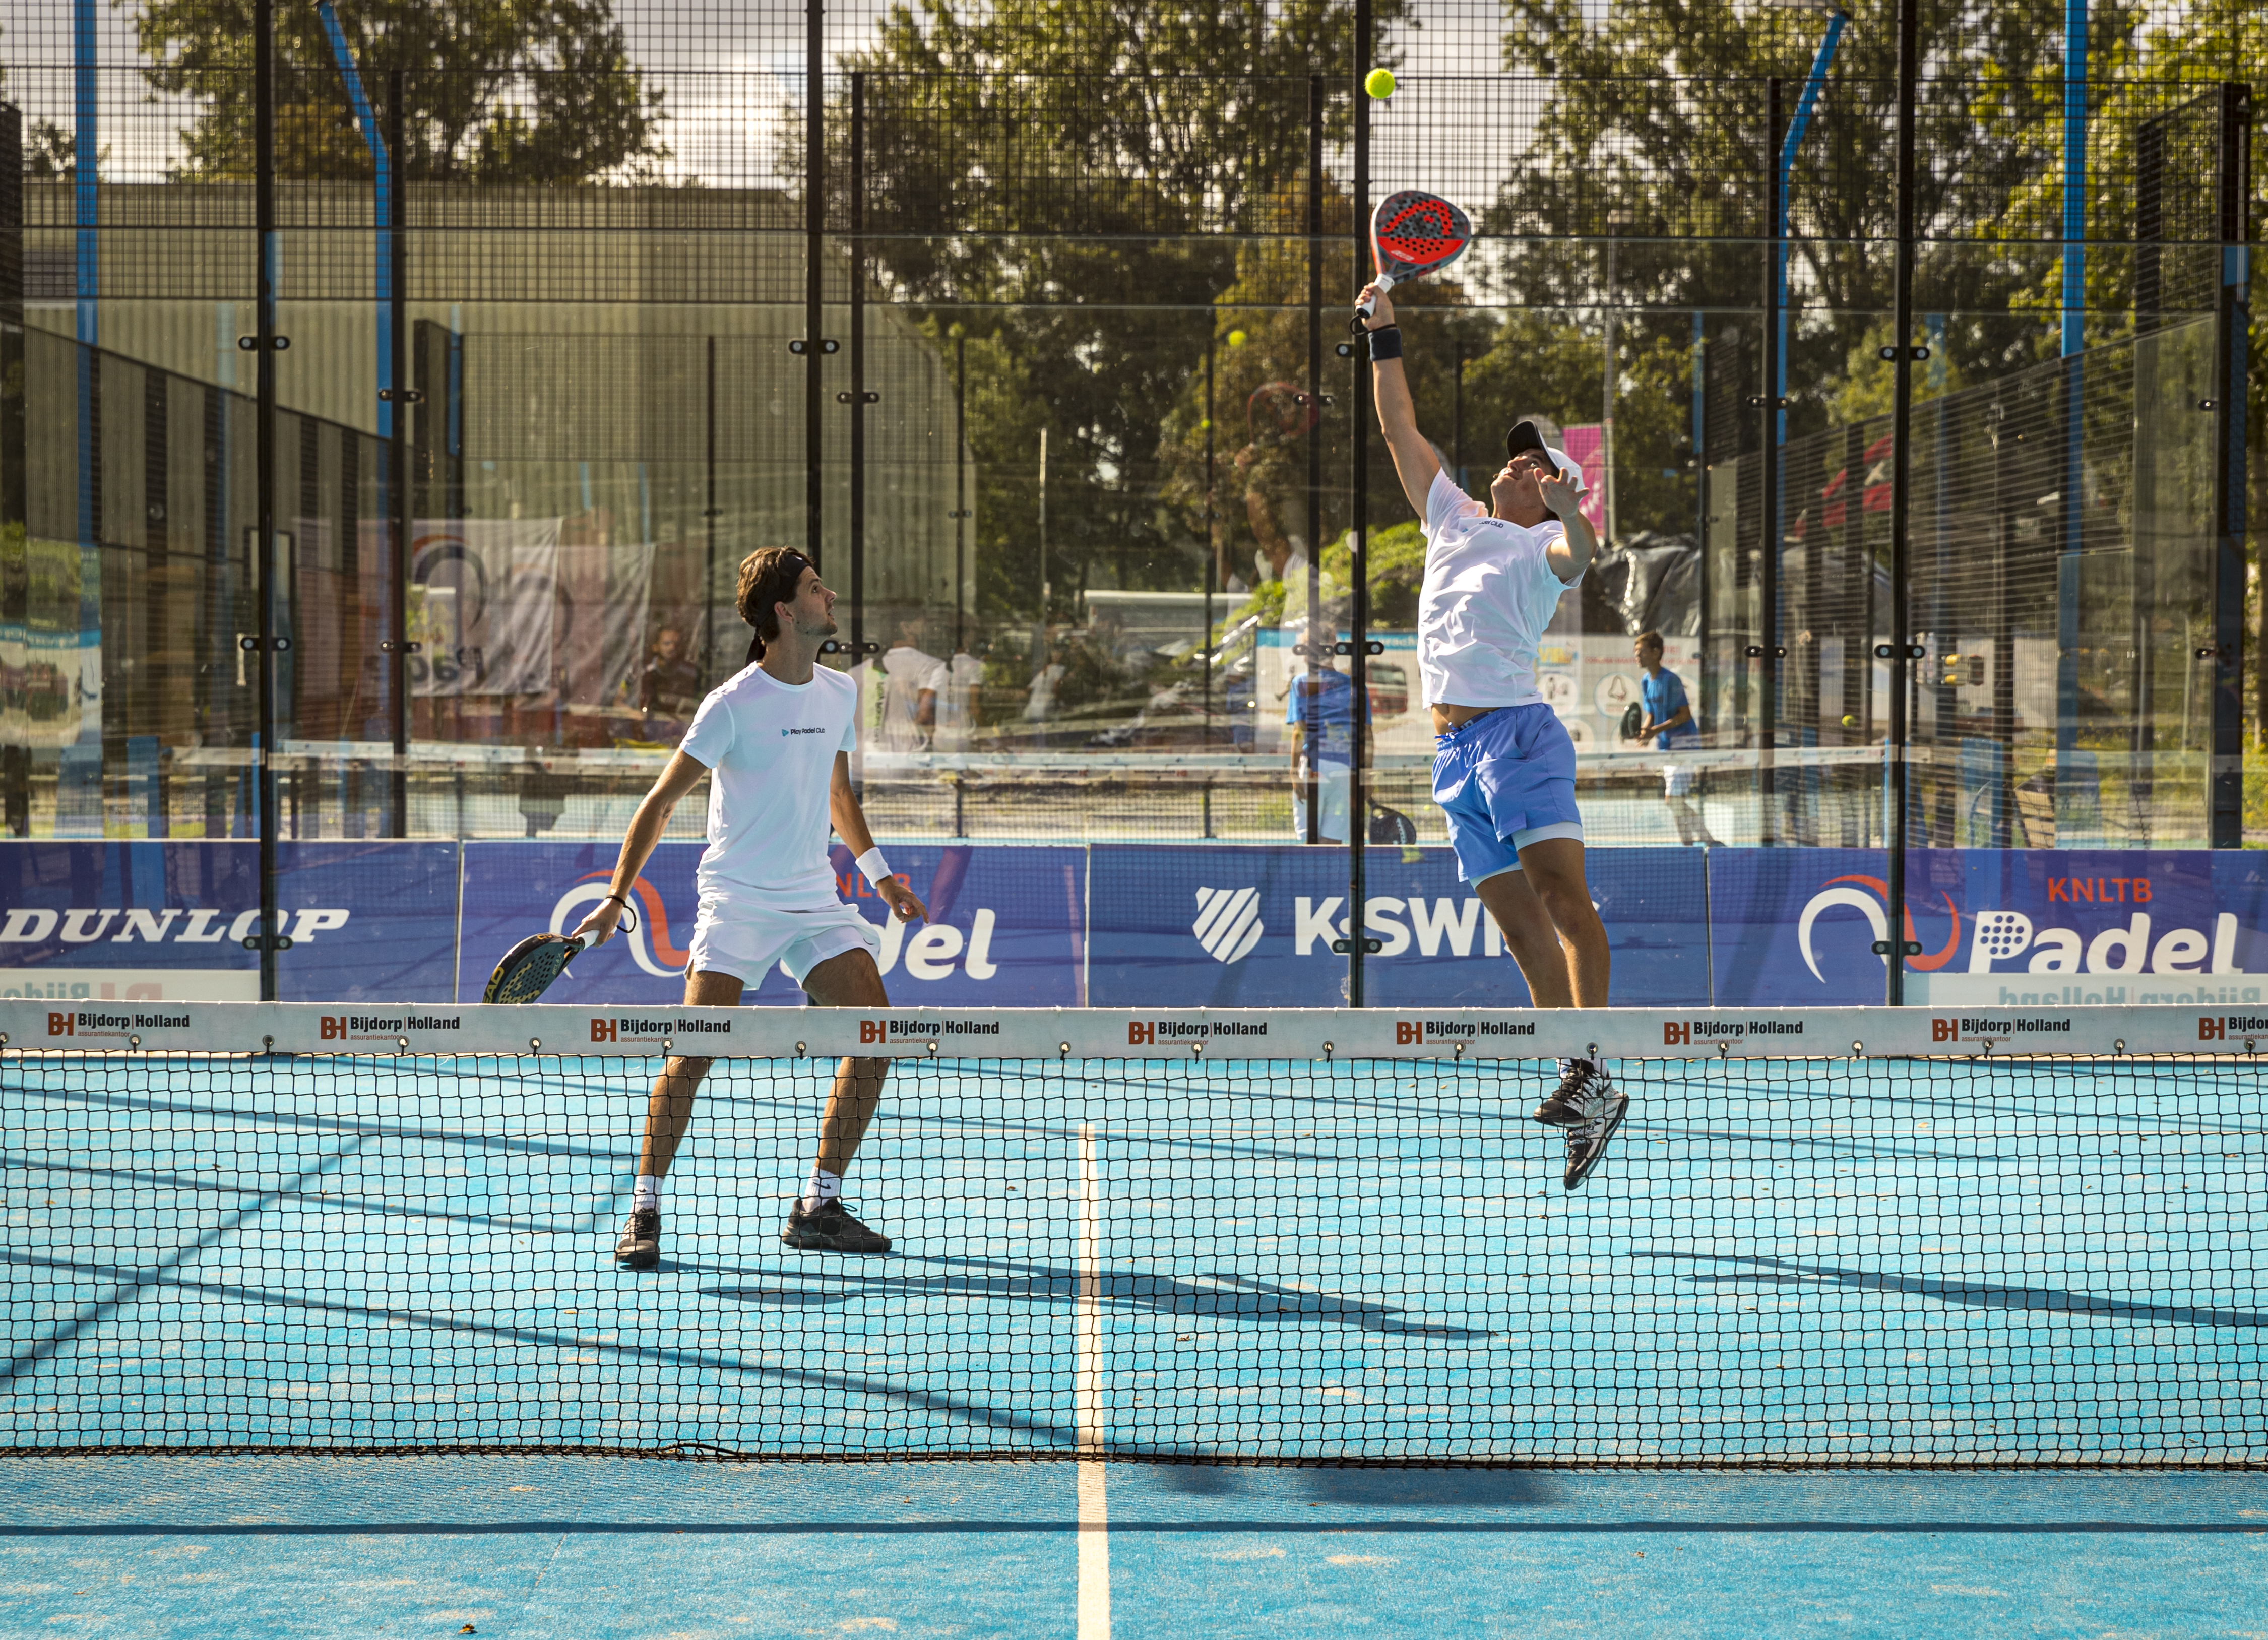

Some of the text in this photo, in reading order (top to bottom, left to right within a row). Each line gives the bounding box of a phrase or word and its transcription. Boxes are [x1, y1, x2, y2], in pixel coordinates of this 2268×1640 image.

[2047, 878, 2153, 903] KNLTB
[1, 909, 350, 942] DUNLOP
[1968, 911, 2243, 974] Padel
[482, 966, 505, 1003] EAD
[48, 1012, 75, 1036] BH
[135, 1014, 190, 1027] Holland
[321, 1017, 347, 1039] BH
[408, 1017, 460, 1029] Holland
[591, 1019, 616, 1042] BH
[678, 1019, 731, 1032] Holland
[860, 1020, 886, 1043] BH
[946, 1021, 999, 1034] Holland
[1128, 1022, 1154, 1044] BH
[1213, 1022, 1267, 1035] Holland
[1396, 1021, 1422, 1044] BH
[1481, 1022, 1535, 1035] Holland
[1664, 1022, 1690, 1045] BH
[1749, 1021, 1803, 1034] Holland
[1932, 1019, 1958, 1042] BH
[2017, 1019, 2070, 1032] Holland
[2199, 1017, 2268, 1040] BH Bijdor
